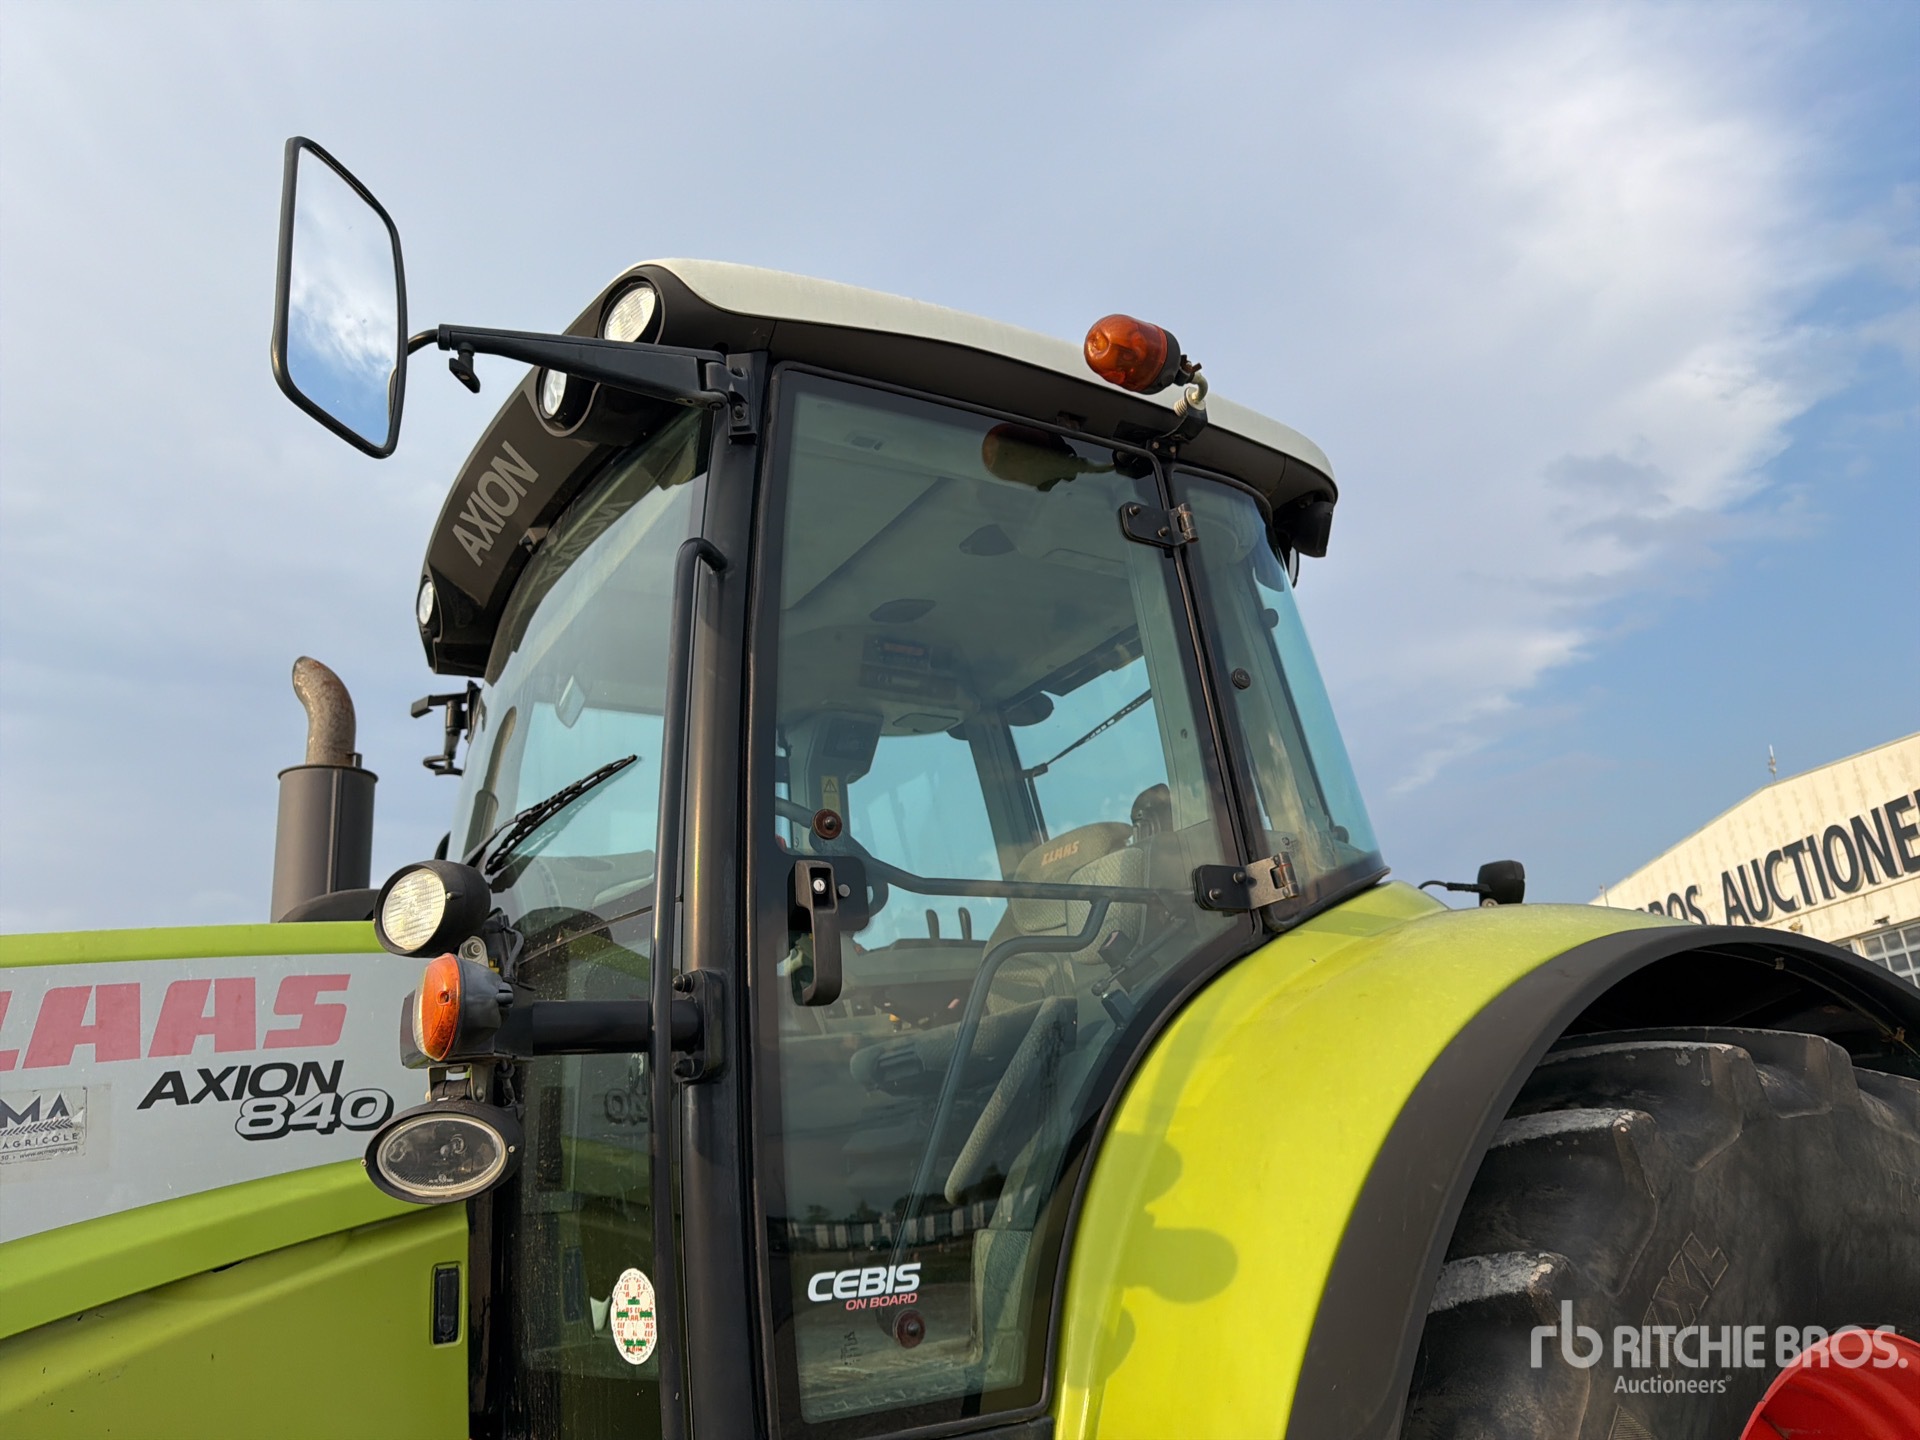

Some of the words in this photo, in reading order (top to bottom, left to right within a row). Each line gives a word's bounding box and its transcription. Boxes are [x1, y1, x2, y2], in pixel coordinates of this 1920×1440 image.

[452, 440, 539, 567] AXION
[1042, 841, 1080, 865] CLAAS
[1721, 789, 1920, 926] AUCTIONE
[0, 974, 351, 1072] AAS
[137, 1060, 344, 1110] AXION
[235, 1088, 394, 1141] 840
[2, 1132, 79, 1150] AGRICOLE
[807, 1262, 922, 1302] CEBIS
[845, 1298, 869, 1311] ON
[869, 1292, 918, 1309] BOARD
